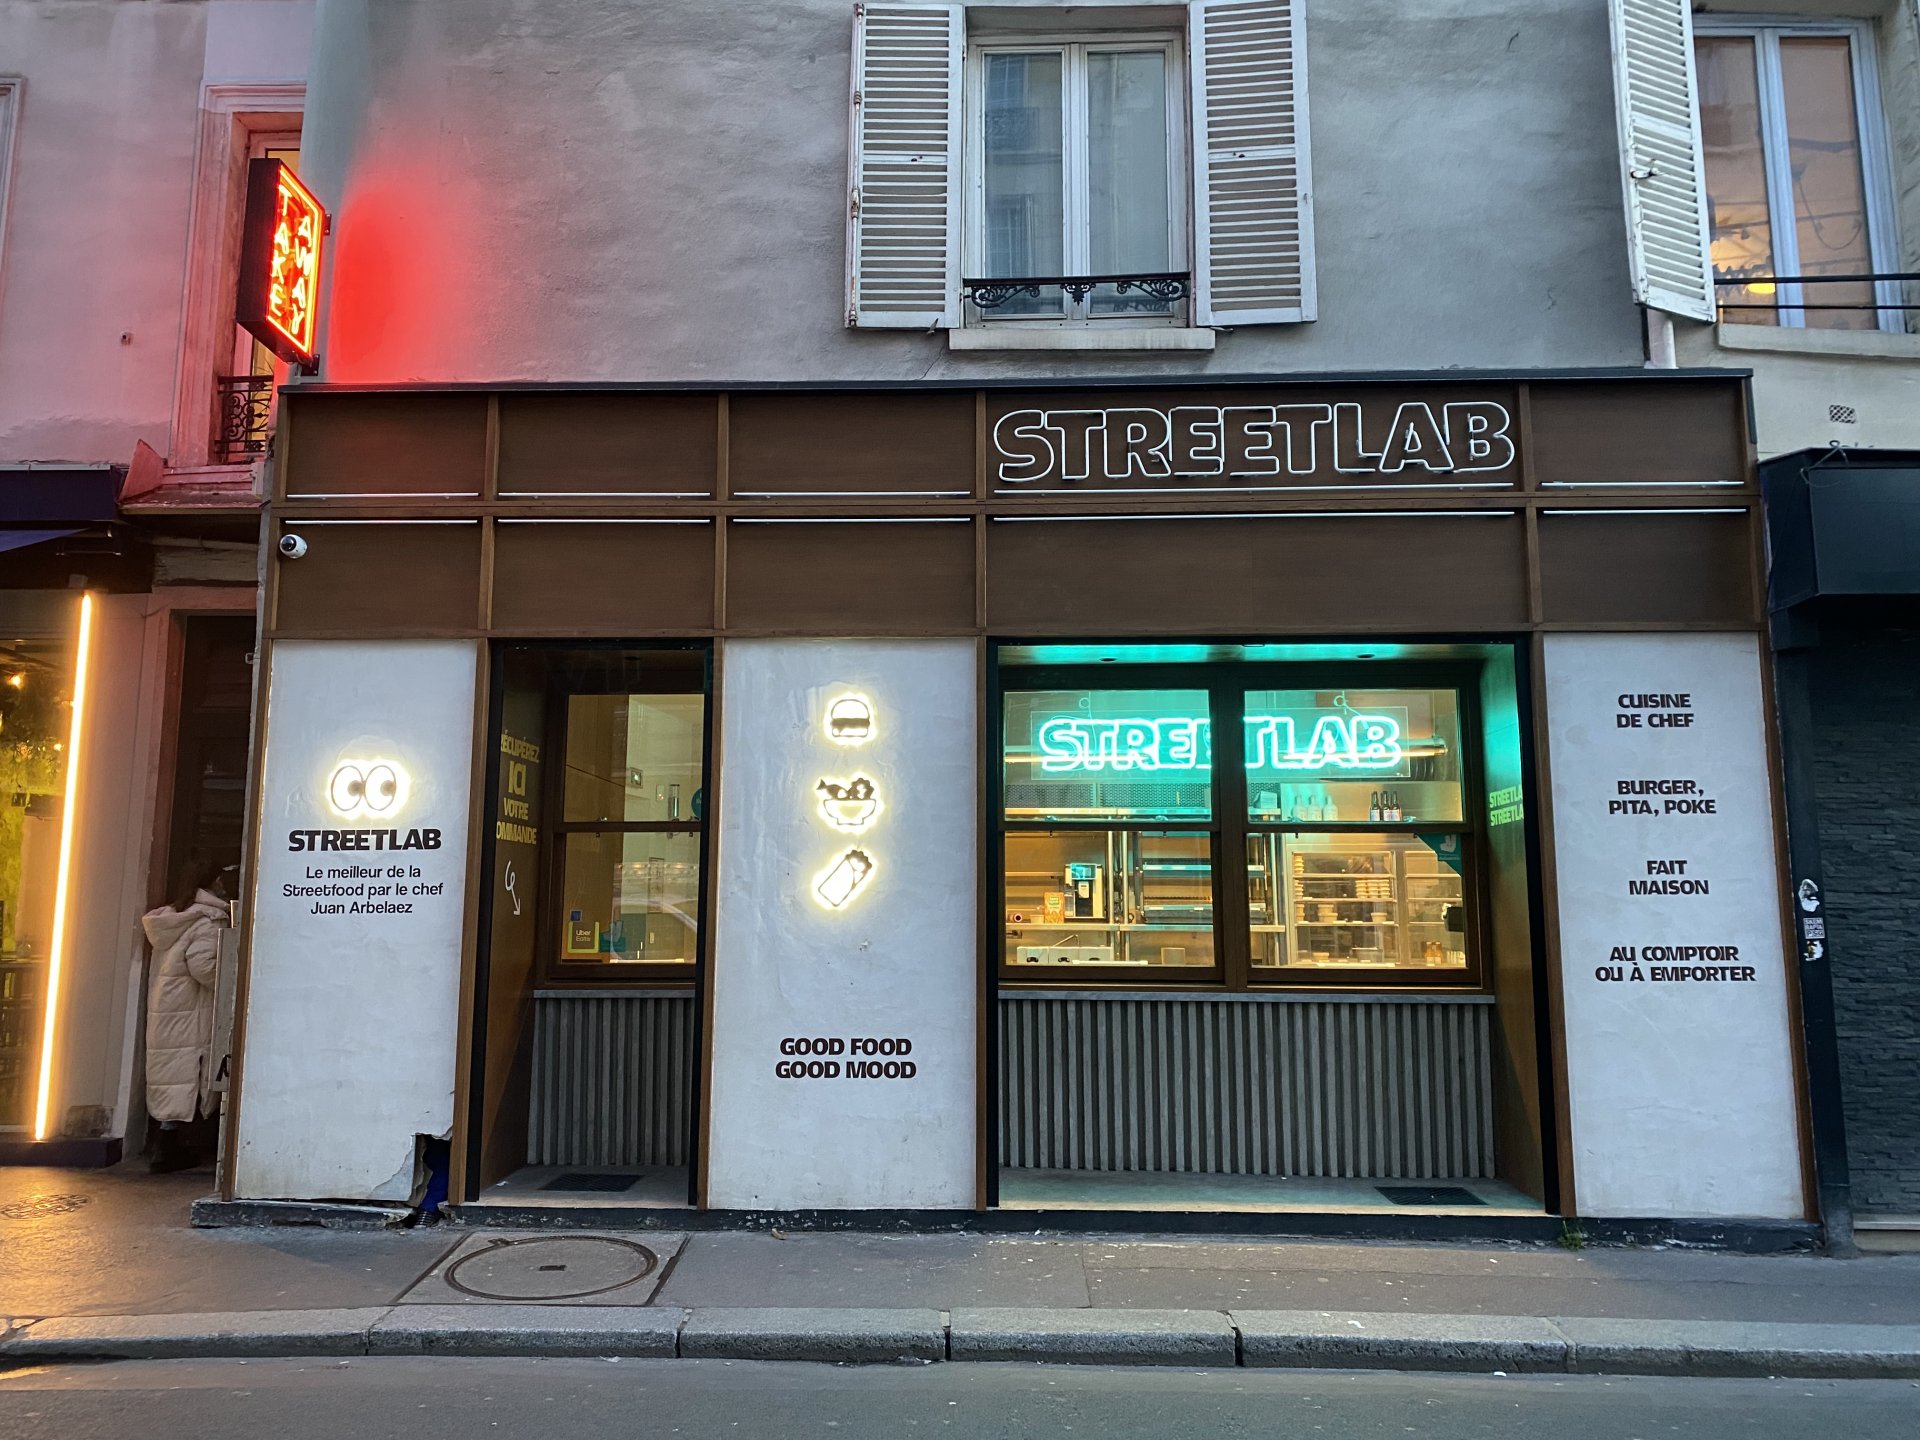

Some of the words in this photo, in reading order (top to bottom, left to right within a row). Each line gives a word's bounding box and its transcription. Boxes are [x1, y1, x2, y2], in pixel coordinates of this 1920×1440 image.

[270, 184, 292, 317] TAKE
[292, 215, 315, 335] AWAY
[994, 402, 1515, 482] STREETLAB
[1617, 693, 1692, 709] CUISINE
[1616, 713, 1643, 729] DE
[1647, 713, 1695, 728] CHEF
[1617, 779, 1705, 797] BURGER,
[503, 797, 529, 821] VOTRE
[1490, 804, 1524, 827] STREETLA
[1608, 799, 1660, 817] PITA,
[1664, 799, 1717, 815] POKE
[288, 828, 442, 852] STREETLAB
[496, 821, 538, 845] OMMANDE
[306, 866, 323, 879] Le
[327, 866, 382, 879] meilleur
[387, 865, 405, 878] de
[409, 865, 421, 878] la
[1646, 860, 1688, 875] FAIT
[282, 883, 364, 897] Streetfood
[368, 885, 391, 900] par
[396, 883, 408, 896] le
[412, 882, 444, 896] chef
[1628, 880, 1710, 895] MAISON
[310, 902, 345, 914] Juan
[349, 901, 413, 914] Arbelaez
[1609, 946, 1637, 962] AU
[1641, 946, 1740, 961] COMPTOIR
[1595, 966, 1624, 982] OU
[1629, 962, 1645, 982] À
[1650, 966, 1757, 982] EMPORTER
[779, 1037, 845, 1056] GOOD
[850, 1037, 913, 1056] FOOD
[775, 1060, 841, 1079] GOOD
[845, 1060, 917, 1079] MOOD
